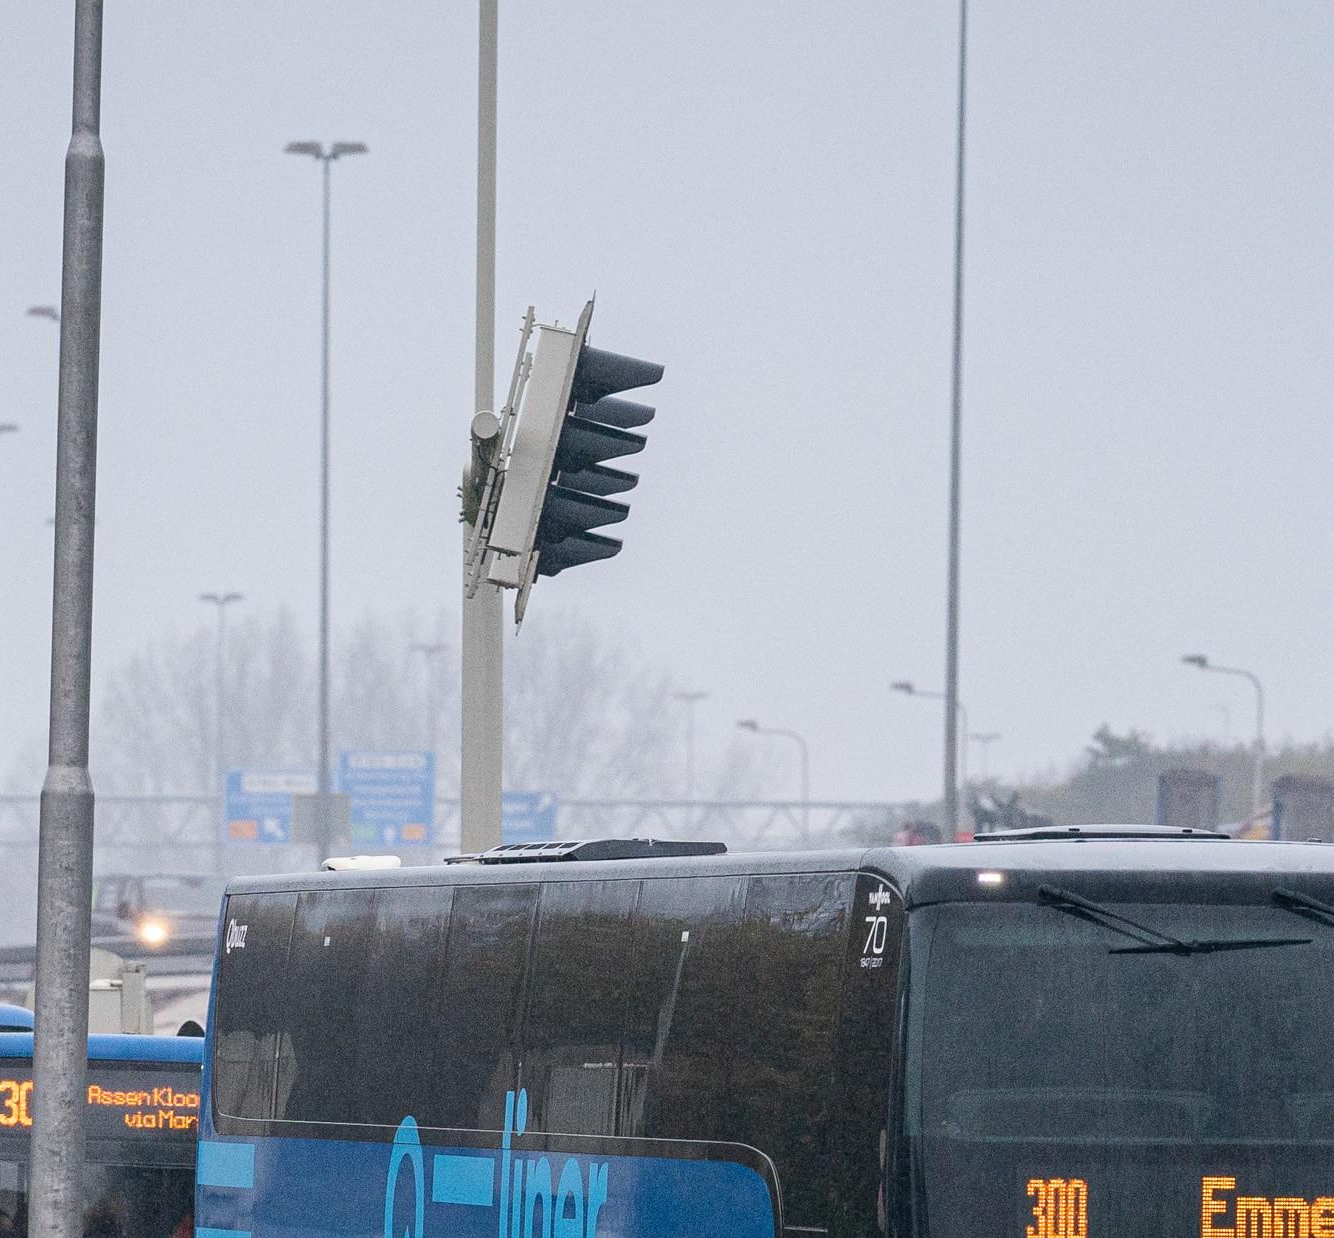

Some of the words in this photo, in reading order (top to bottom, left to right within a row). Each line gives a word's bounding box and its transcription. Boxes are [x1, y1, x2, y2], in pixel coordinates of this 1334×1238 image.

[226, 919, 248, 954] Qbuzz
[863, 916, 887, 954] 70
[87, 1084, 152, 1106] Assen
[124, 1110, 157, 1129] via
